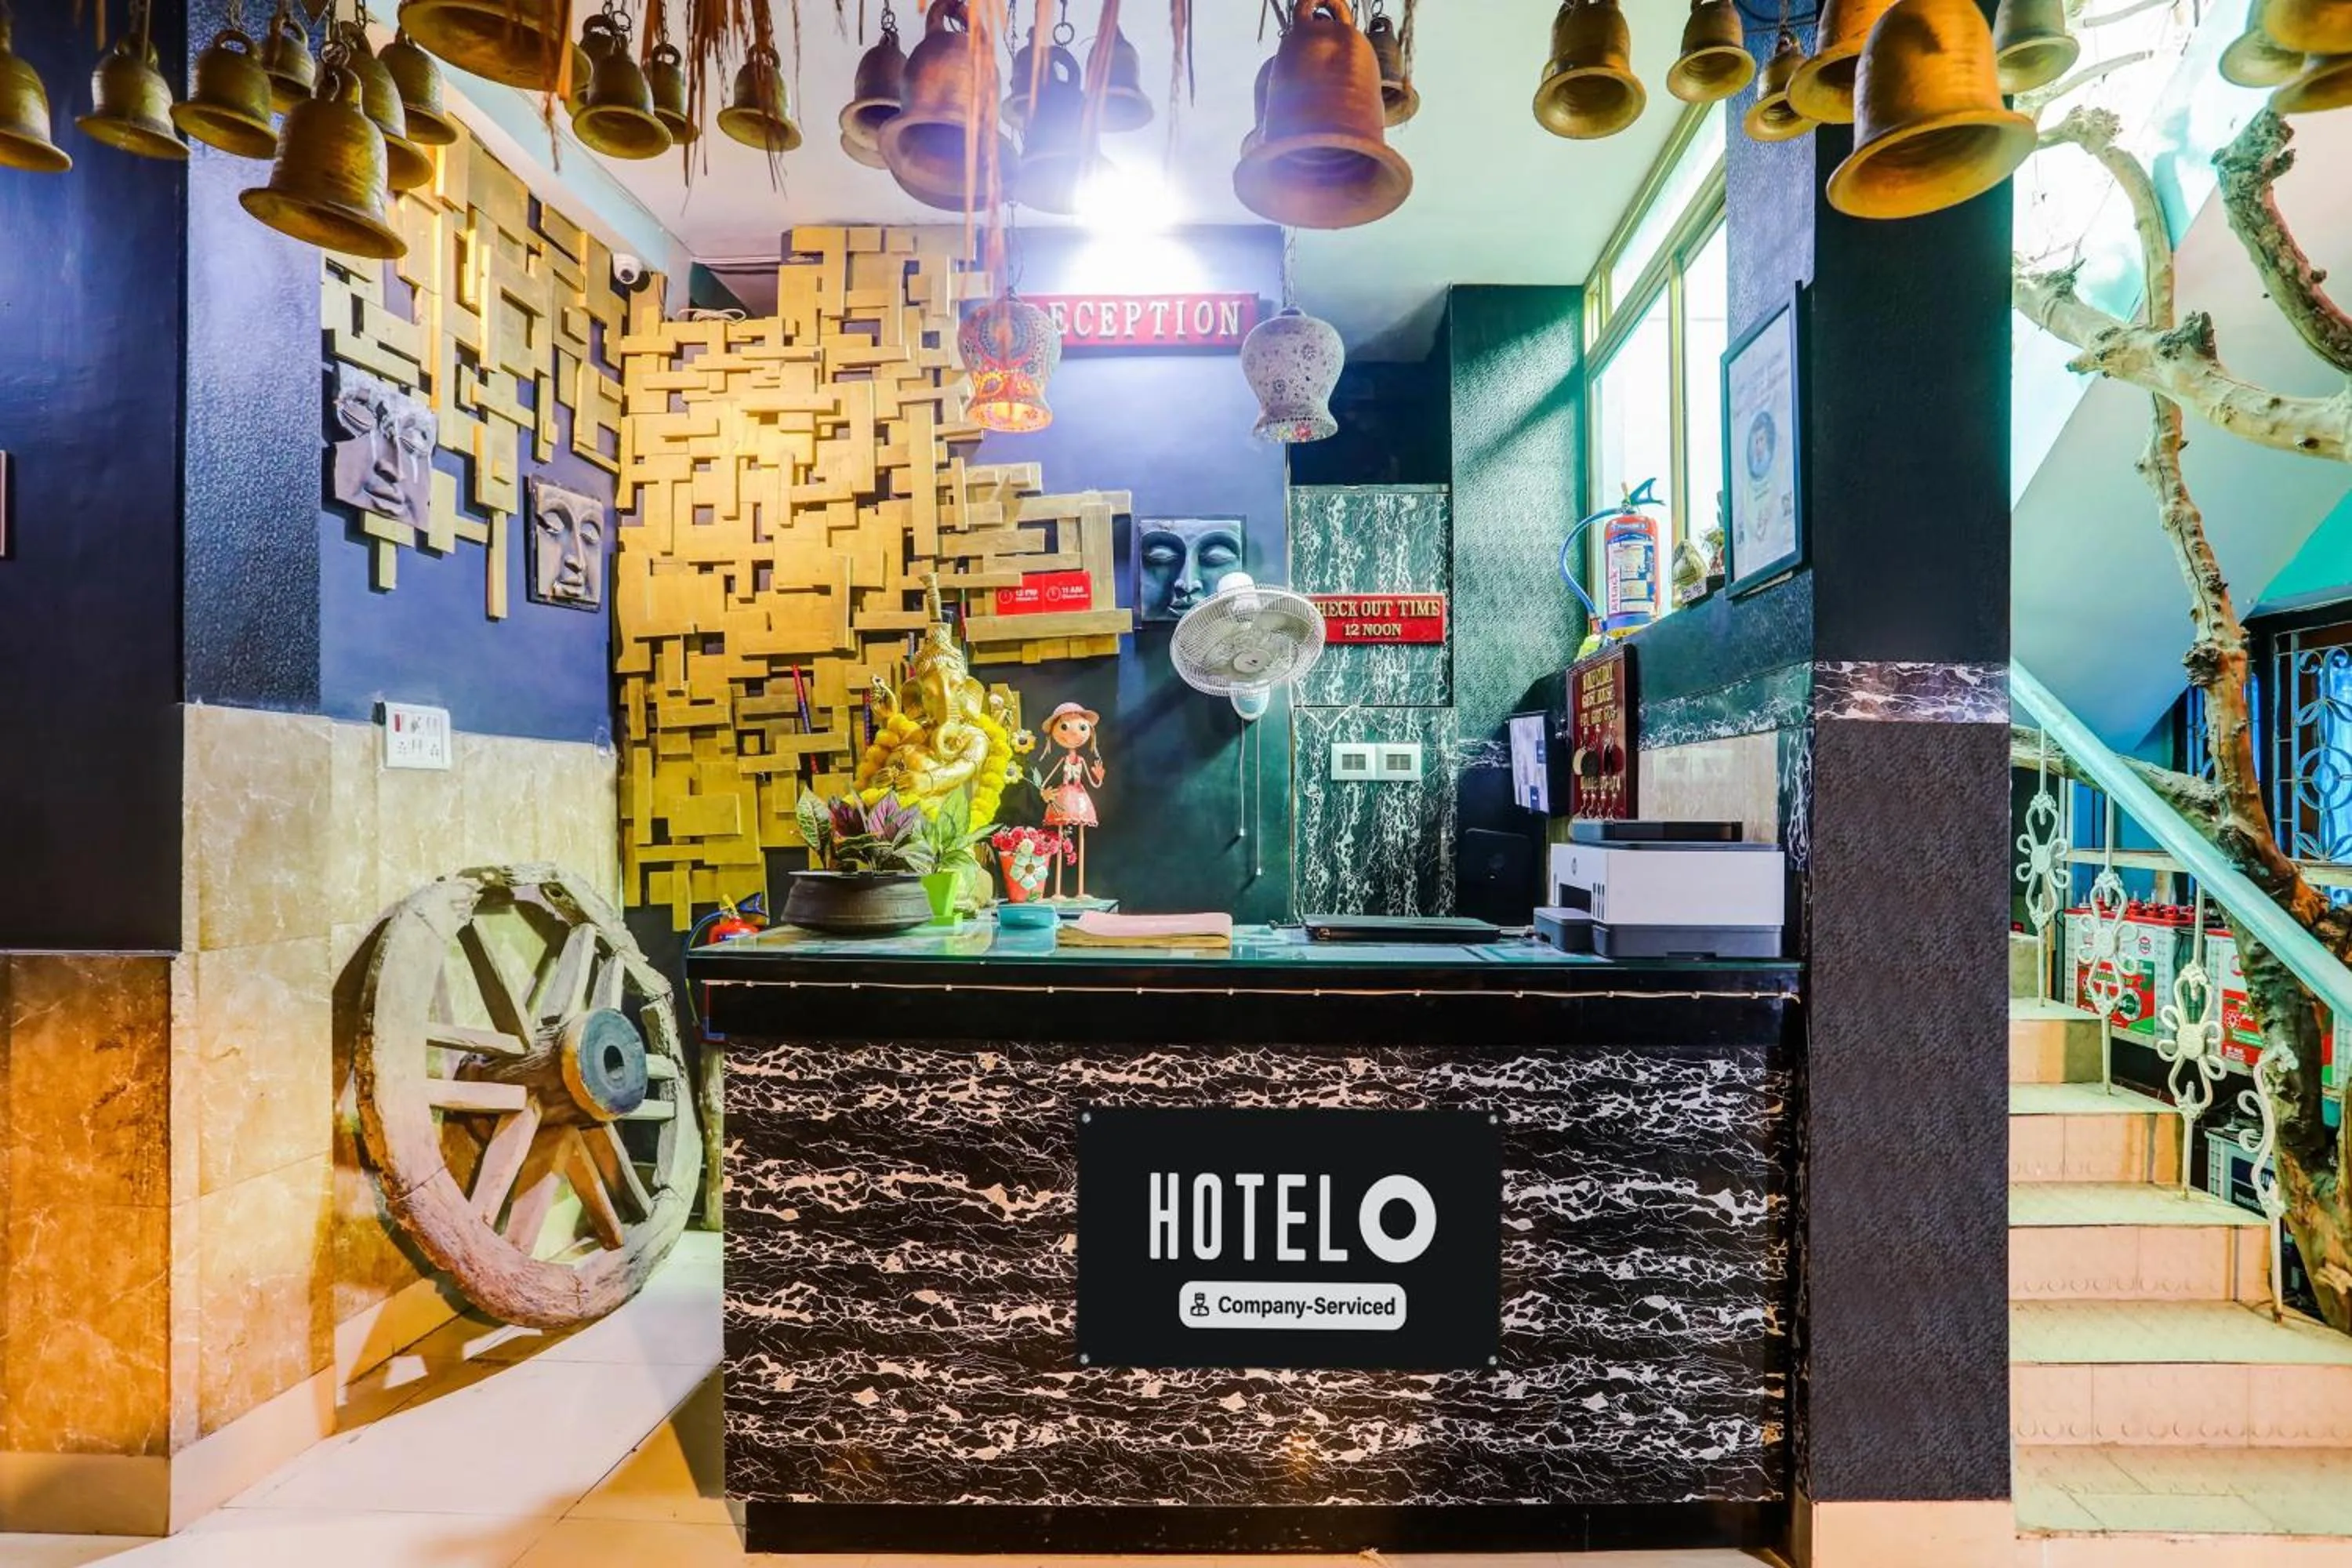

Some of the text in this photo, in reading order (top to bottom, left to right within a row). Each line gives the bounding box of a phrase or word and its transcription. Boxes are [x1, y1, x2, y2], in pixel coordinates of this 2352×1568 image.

[1047, 300, 1243, 337] ECEPTION
[1314, 600, 1440, 617] HECK OUT TIME
[1345, 623, 1402, 636] 12 NOON
[1149, 1172, 1348, 1262] HOTEL
[1218, 1296, 1396, 1319] Company-Serviced
